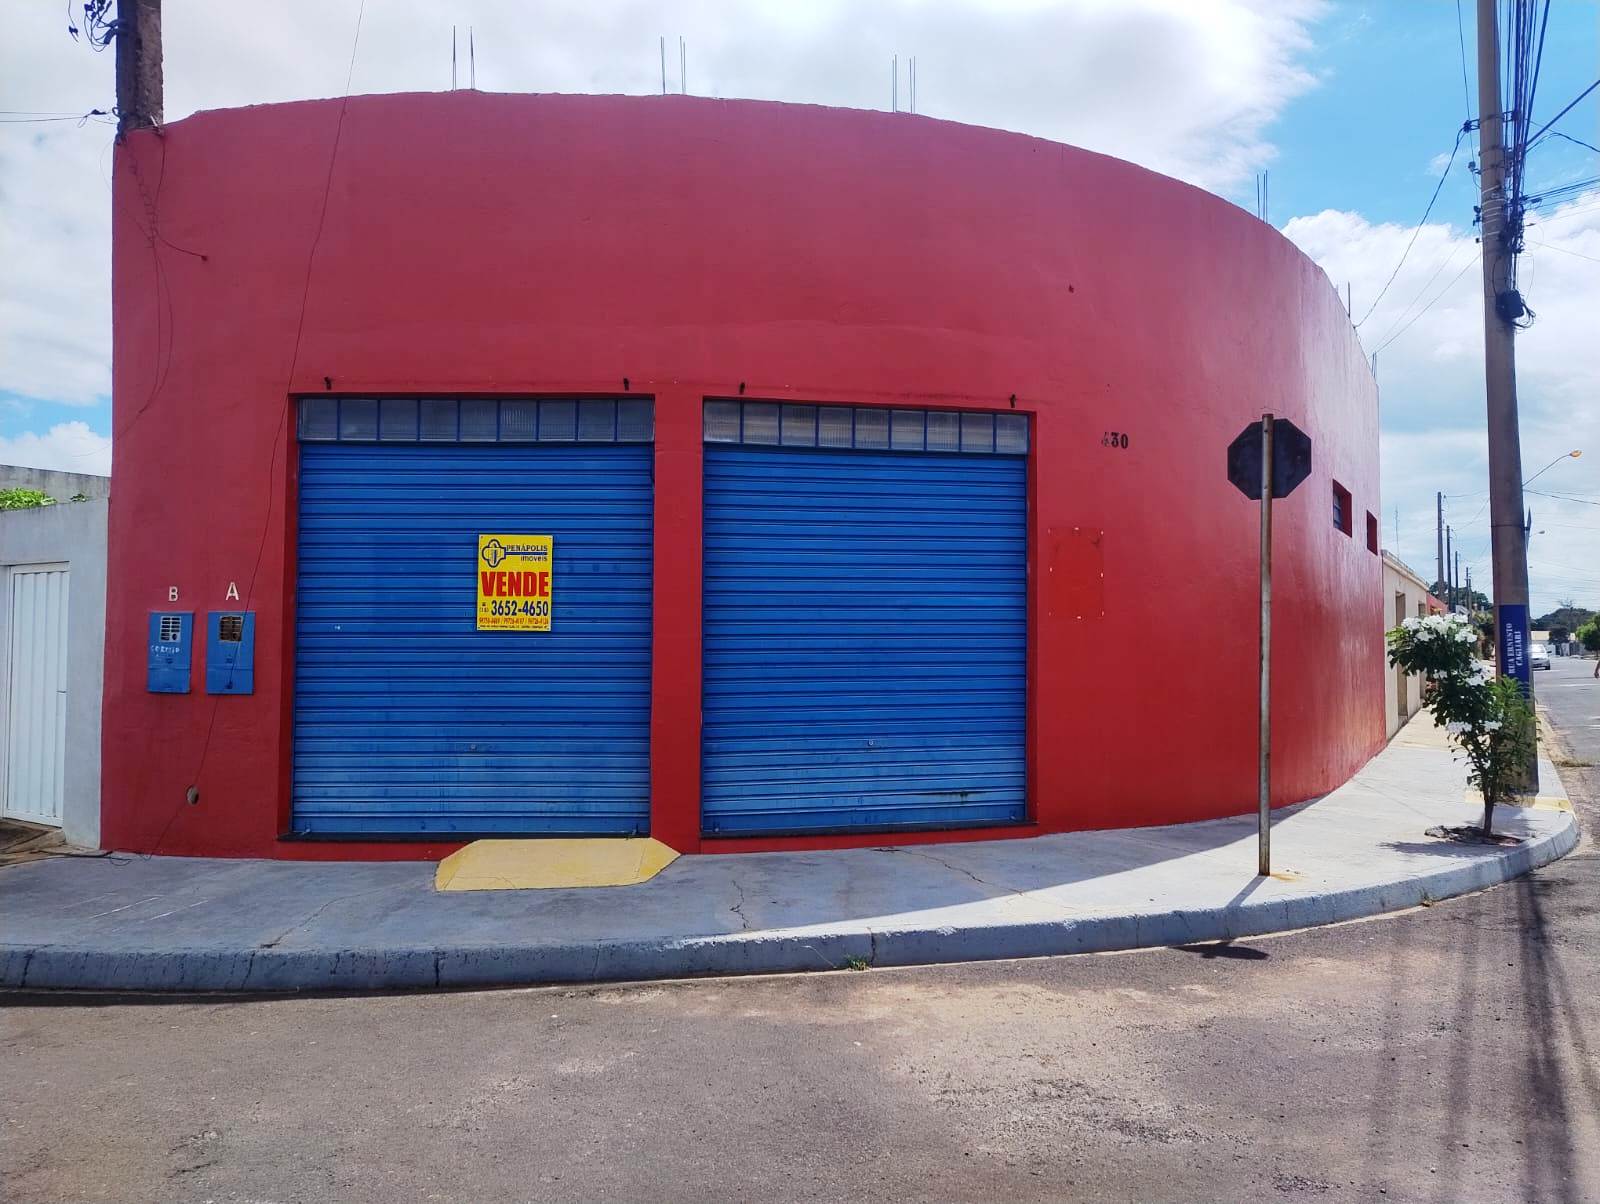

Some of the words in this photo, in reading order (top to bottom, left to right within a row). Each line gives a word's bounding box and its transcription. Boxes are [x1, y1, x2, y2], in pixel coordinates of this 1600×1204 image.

[225, 581, 239, 600] A
[481, 571, 549, 597] VENDE
[168, 586, 178, 601] B
[491, 600, 548, 616] 3652-4650
[1506, 623, 1515, 657] ERNESTO
[1507, 658, 1515, 674] RUA
